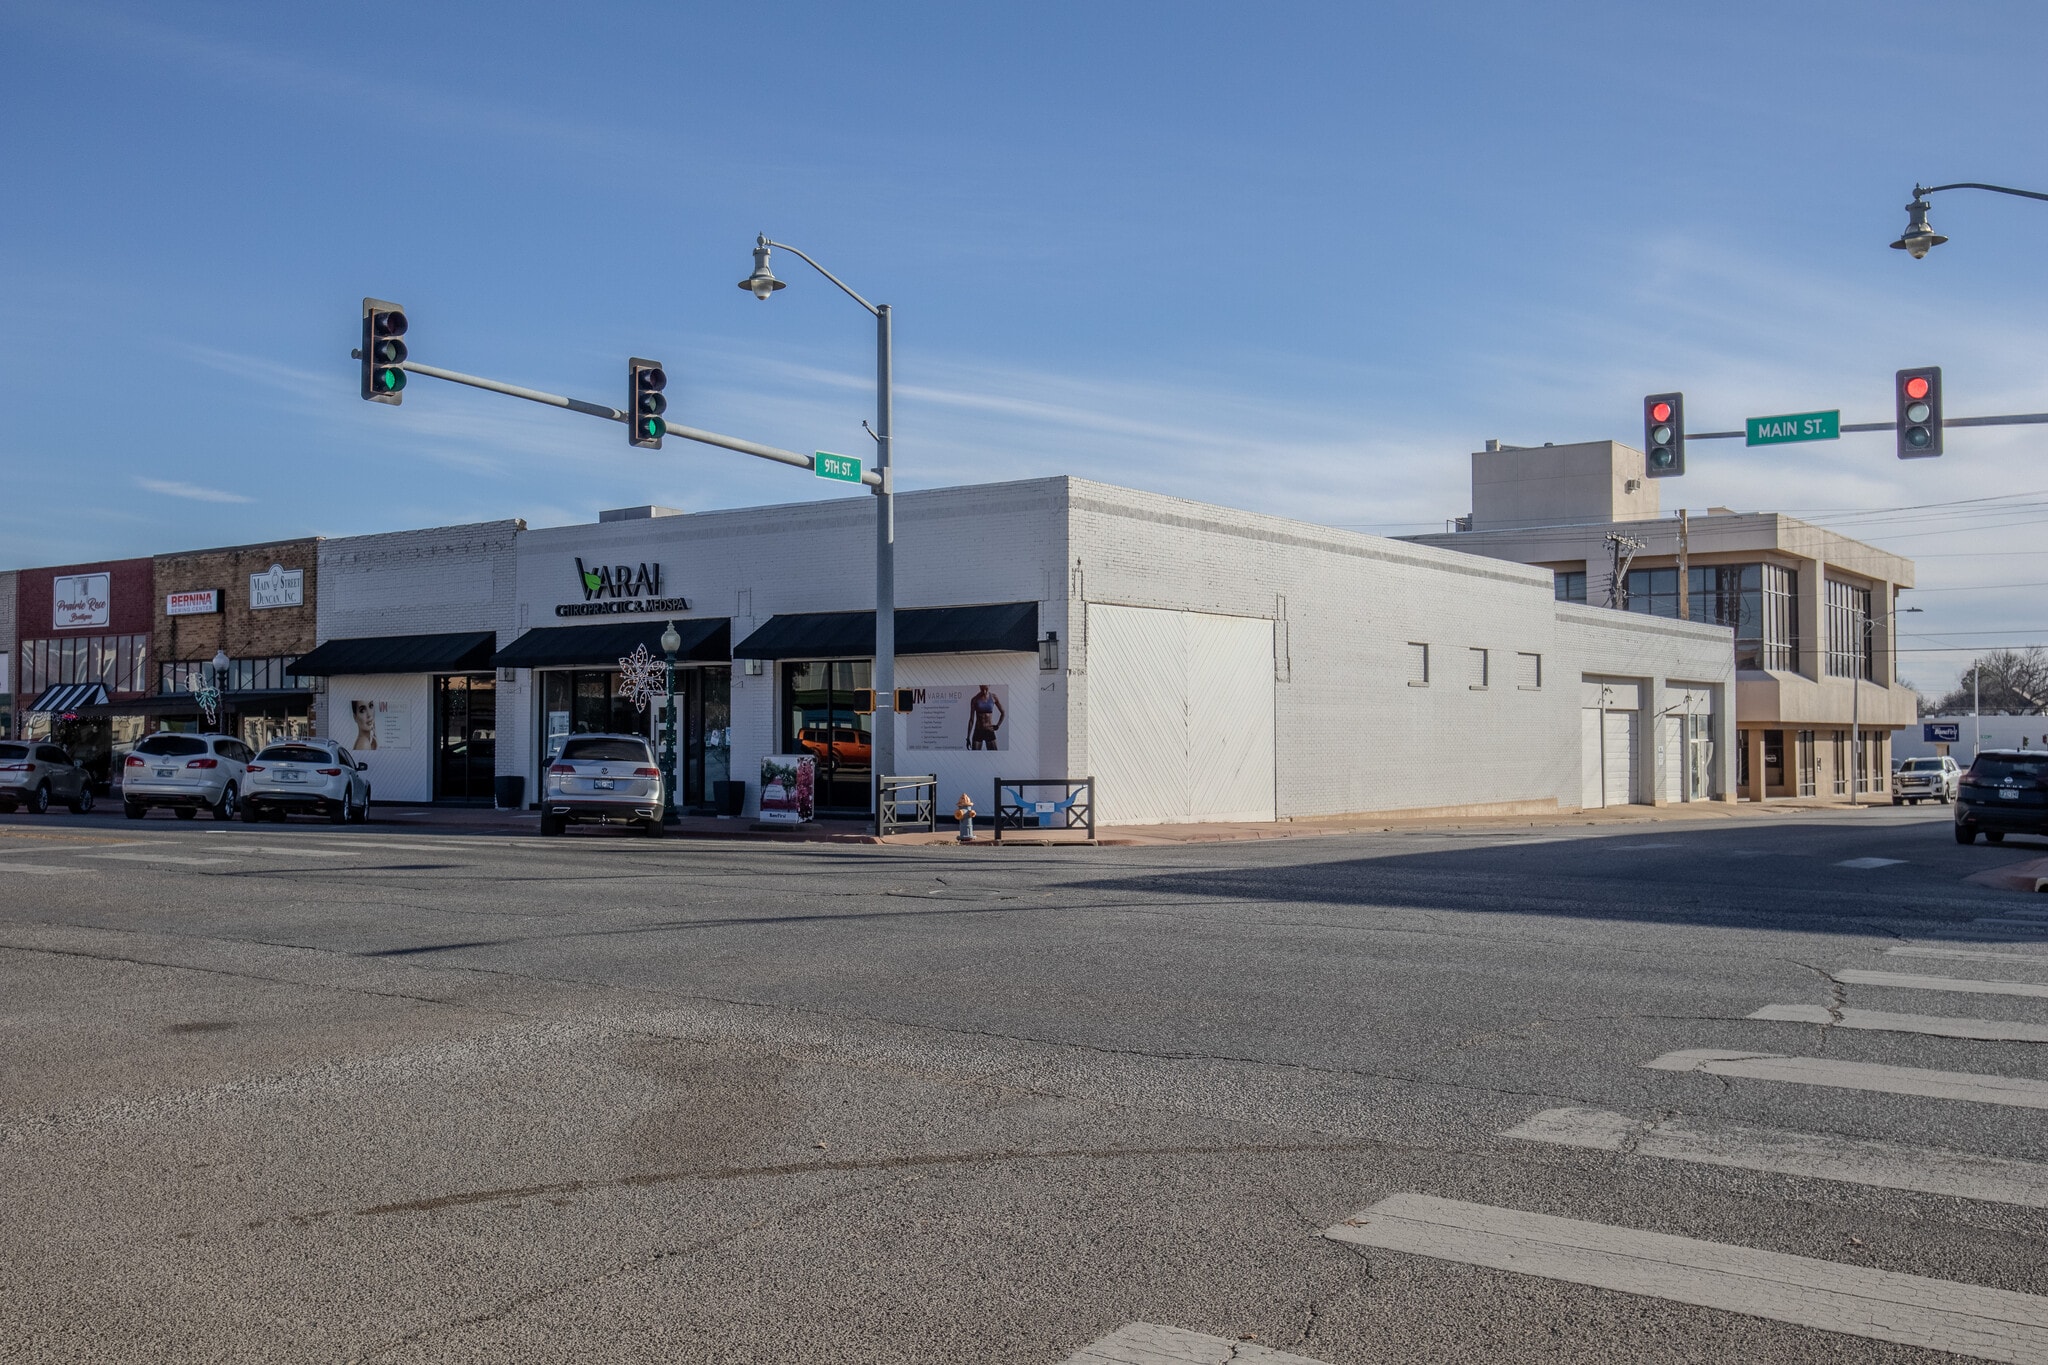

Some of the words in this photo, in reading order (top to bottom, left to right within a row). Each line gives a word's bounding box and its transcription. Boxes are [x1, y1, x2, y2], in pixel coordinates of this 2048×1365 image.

[1758, 421, 1797, 439] MAIN
[1803, 418, 1826, 435] ST.
[824, 458, 840, 474] 9TH
[841, 461, 853, 477] ST.
[253, 578, 270, 591] MAIN
[280, 576, 300, 589] STREET
[574, 557, 660, 601] VARAI
[171, 593, 213, 608] BERNINA
[284, 590, 297, 603] INC.
[57, 600, 86, 612] Prairie
[87, 597, 106, 612] Rose
[555, 601, 633, 617] CHIROPRACTIC
[634, 600, 644, 612] &
[645, 598, 689, 612] MEDSPA
[69, 612, 93, 623] Boutique
[927, 692, 947, 700] VARAI
[948, 691, 963, 700] MED
